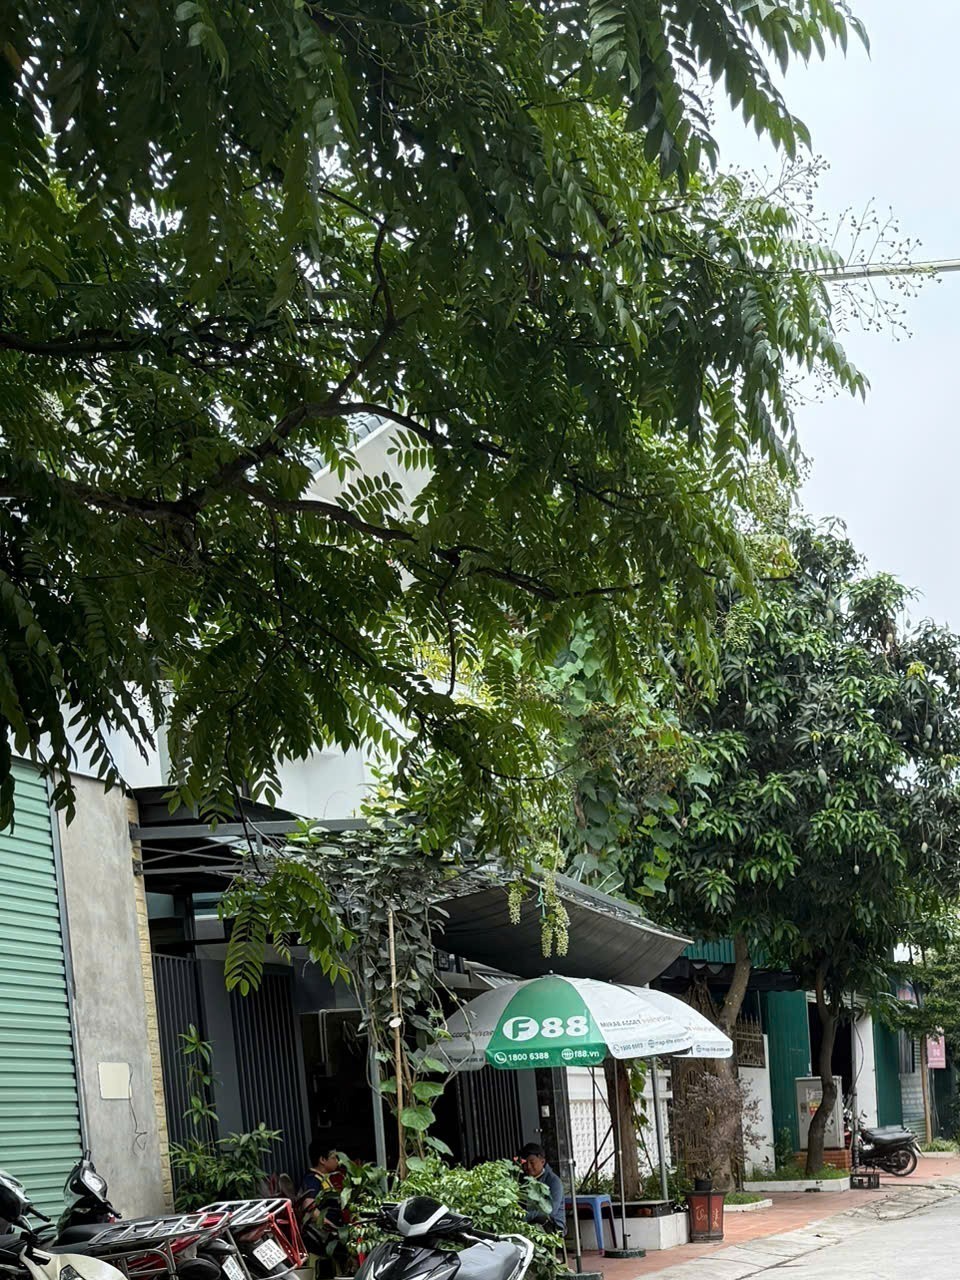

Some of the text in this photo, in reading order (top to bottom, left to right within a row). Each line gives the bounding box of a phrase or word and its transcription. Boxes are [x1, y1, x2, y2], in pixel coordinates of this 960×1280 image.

[504, 1015, 589, 1041] F88
[508, 1052, 549, 1062] 1800 6388
[574, 1049, 600, 1059] f88.vn
